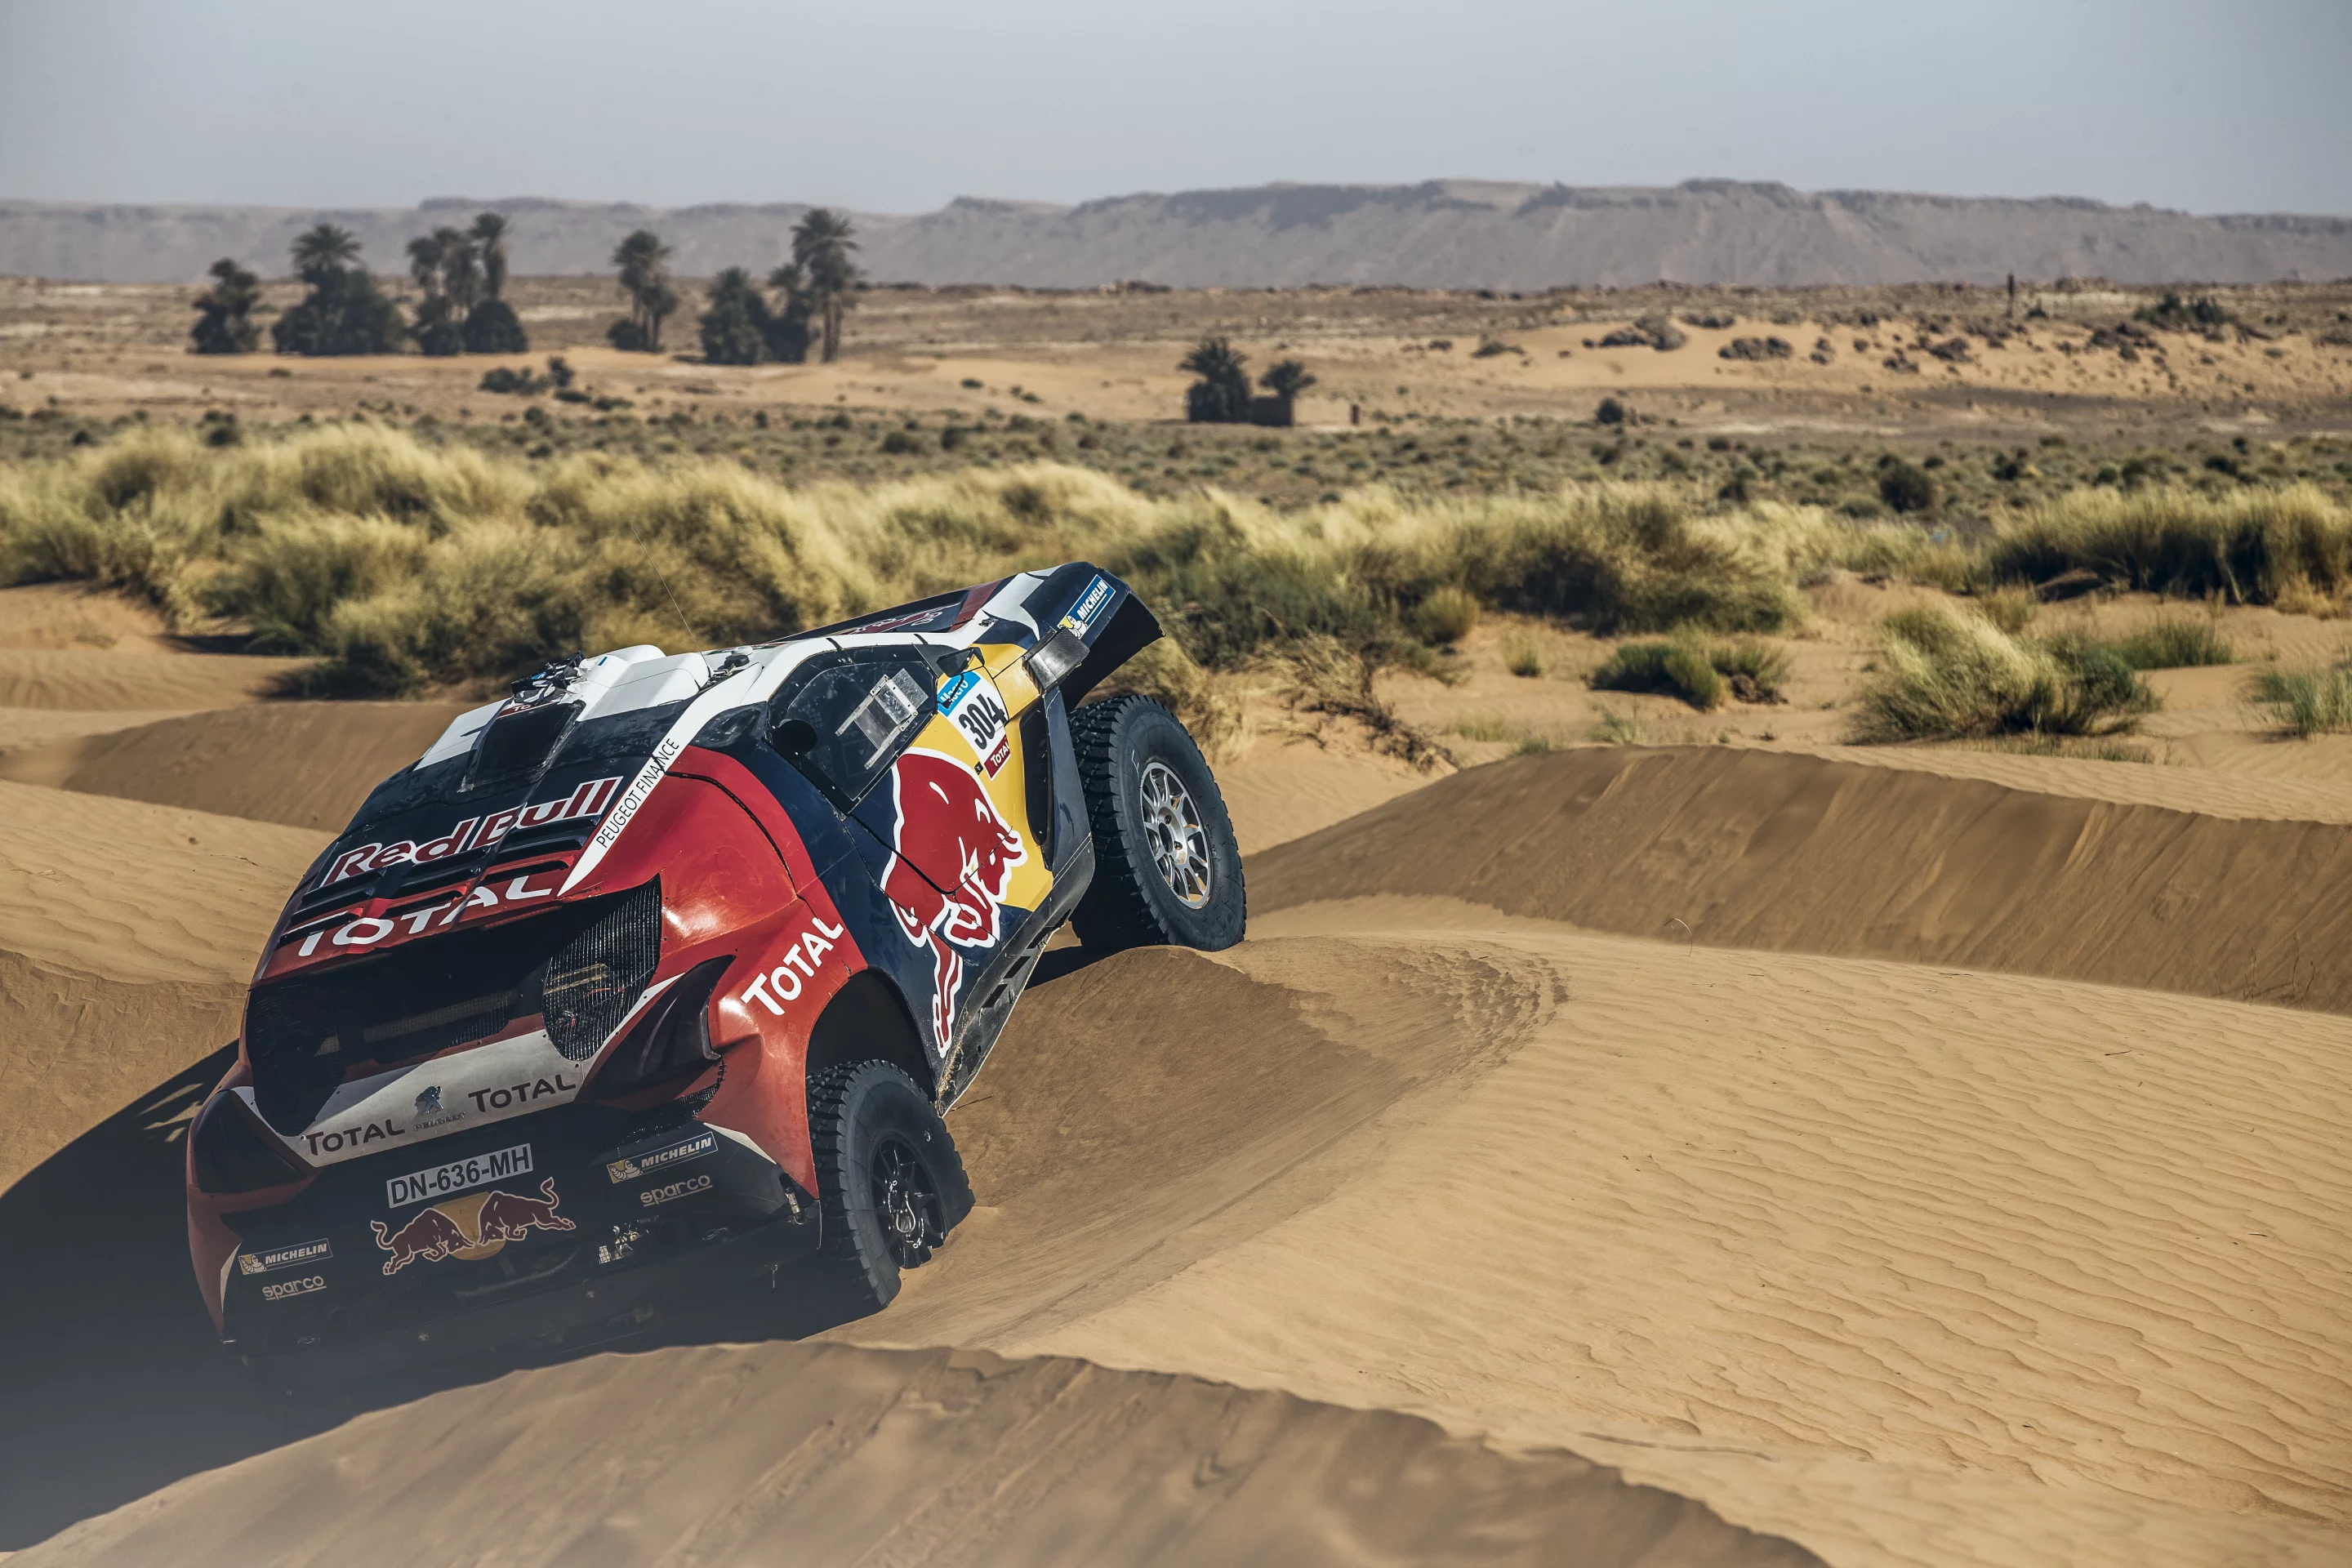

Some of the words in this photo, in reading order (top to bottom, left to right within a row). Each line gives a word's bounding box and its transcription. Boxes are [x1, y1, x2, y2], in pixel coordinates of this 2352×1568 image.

[1076, 579, 1108, 621] MICHELIN
[958, 693, 1008, 751] 304
[595, 790, 642, 849] PEUGEOT
[635, 737, 679, 795] FINANCE
[320, 817, 480, 889] Red
[471, 776, 624, 850] Bull
[740, 916, 844, 1016] TOTAL
[468, 1074, 577, 1112] TOTAL
[305, 1119, 405, 1156] TOTAL
[641, 1137, 711, 1169] MICHELIN
[390, 1146, 531, 1205] DN-636-MH
[639, 1174, 713, 1207] sparco
[265, 1243, 327, 1265] MICHELIN
[262, 1275, 327, 1301] sparco
